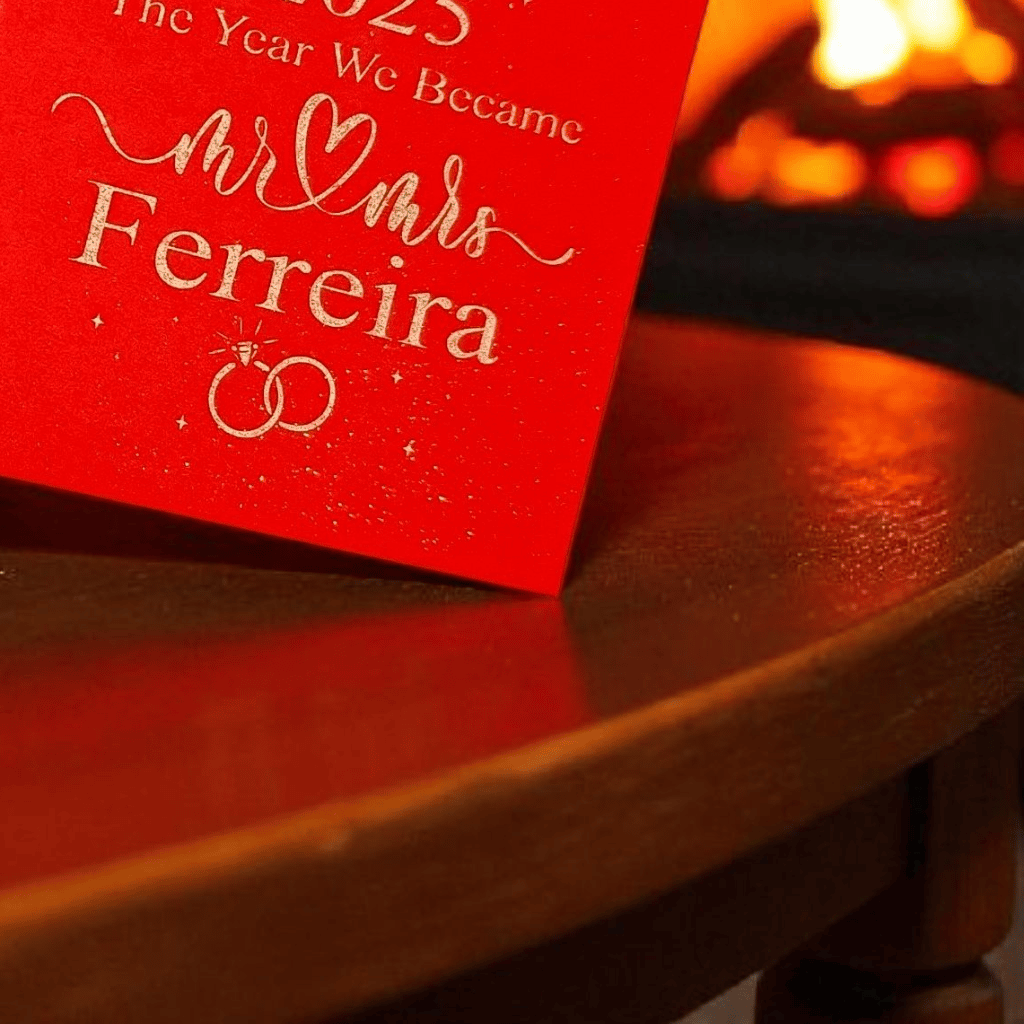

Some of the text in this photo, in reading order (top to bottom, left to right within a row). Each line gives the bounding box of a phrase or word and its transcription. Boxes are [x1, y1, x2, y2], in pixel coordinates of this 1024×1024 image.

[214, 8, 314, 68] Year
[332, 41, 398, 92] We
[412, 66, 584, 145] Became
[68, 179, 499, 366] Ferreira
